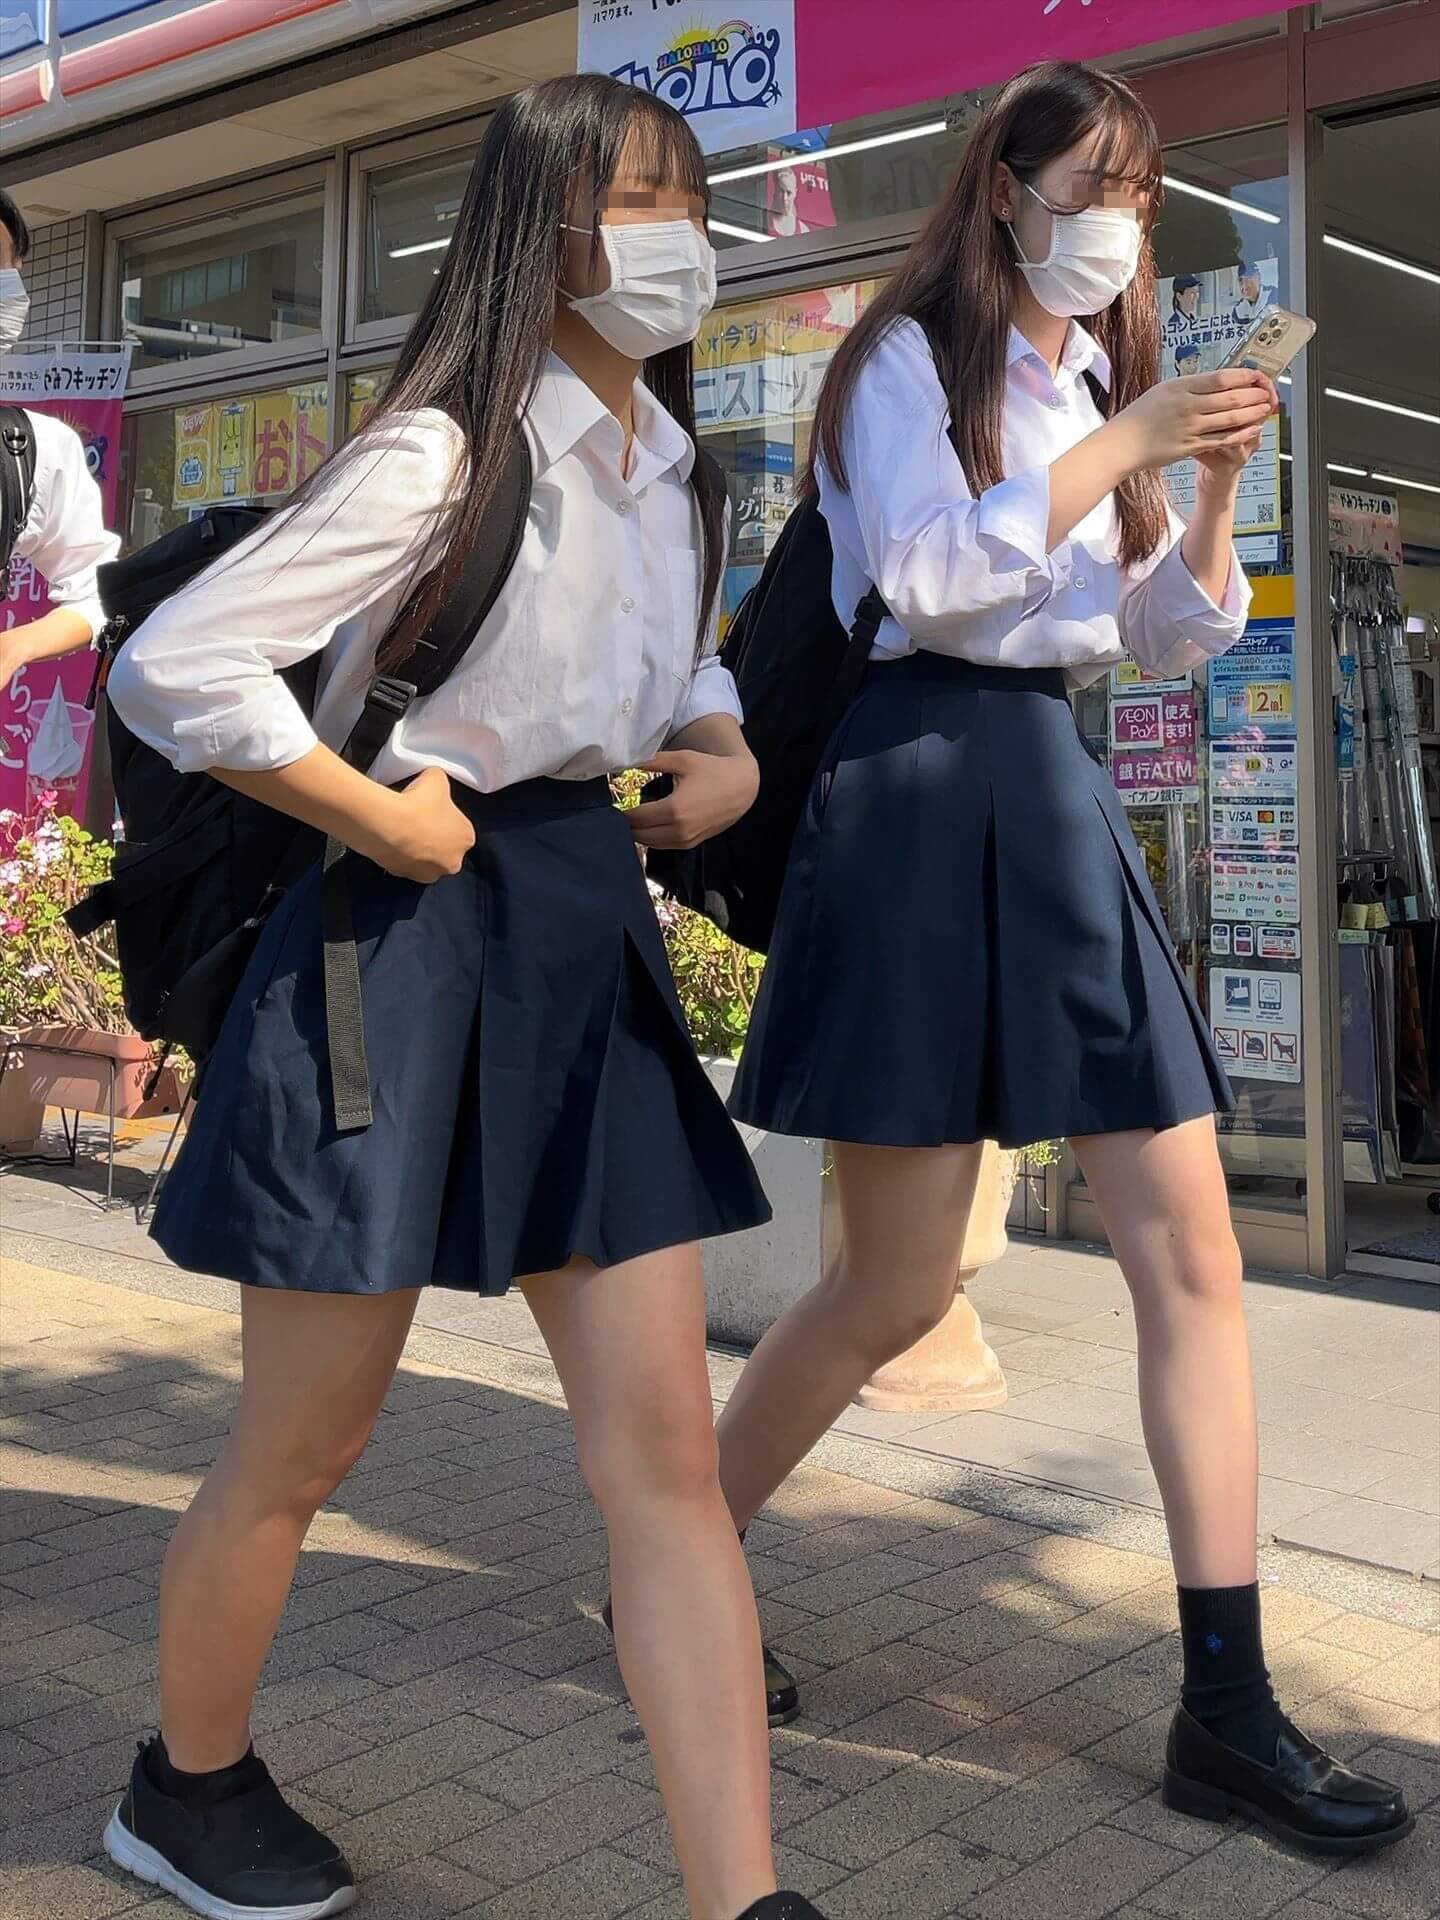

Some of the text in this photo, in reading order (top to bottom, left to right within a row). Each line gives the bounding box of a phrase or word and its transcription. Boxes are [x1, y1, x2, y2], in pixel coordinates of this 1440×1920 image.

[656, 38, 729, 71] HALOHALO
[1165, 704, 1192, 721] 使え
[1119, 760, 1192, 780] 銀行ATM
[1128, 788, 1184, 803] イオン銀行
[1228, 811, 1253, 822] VISA
